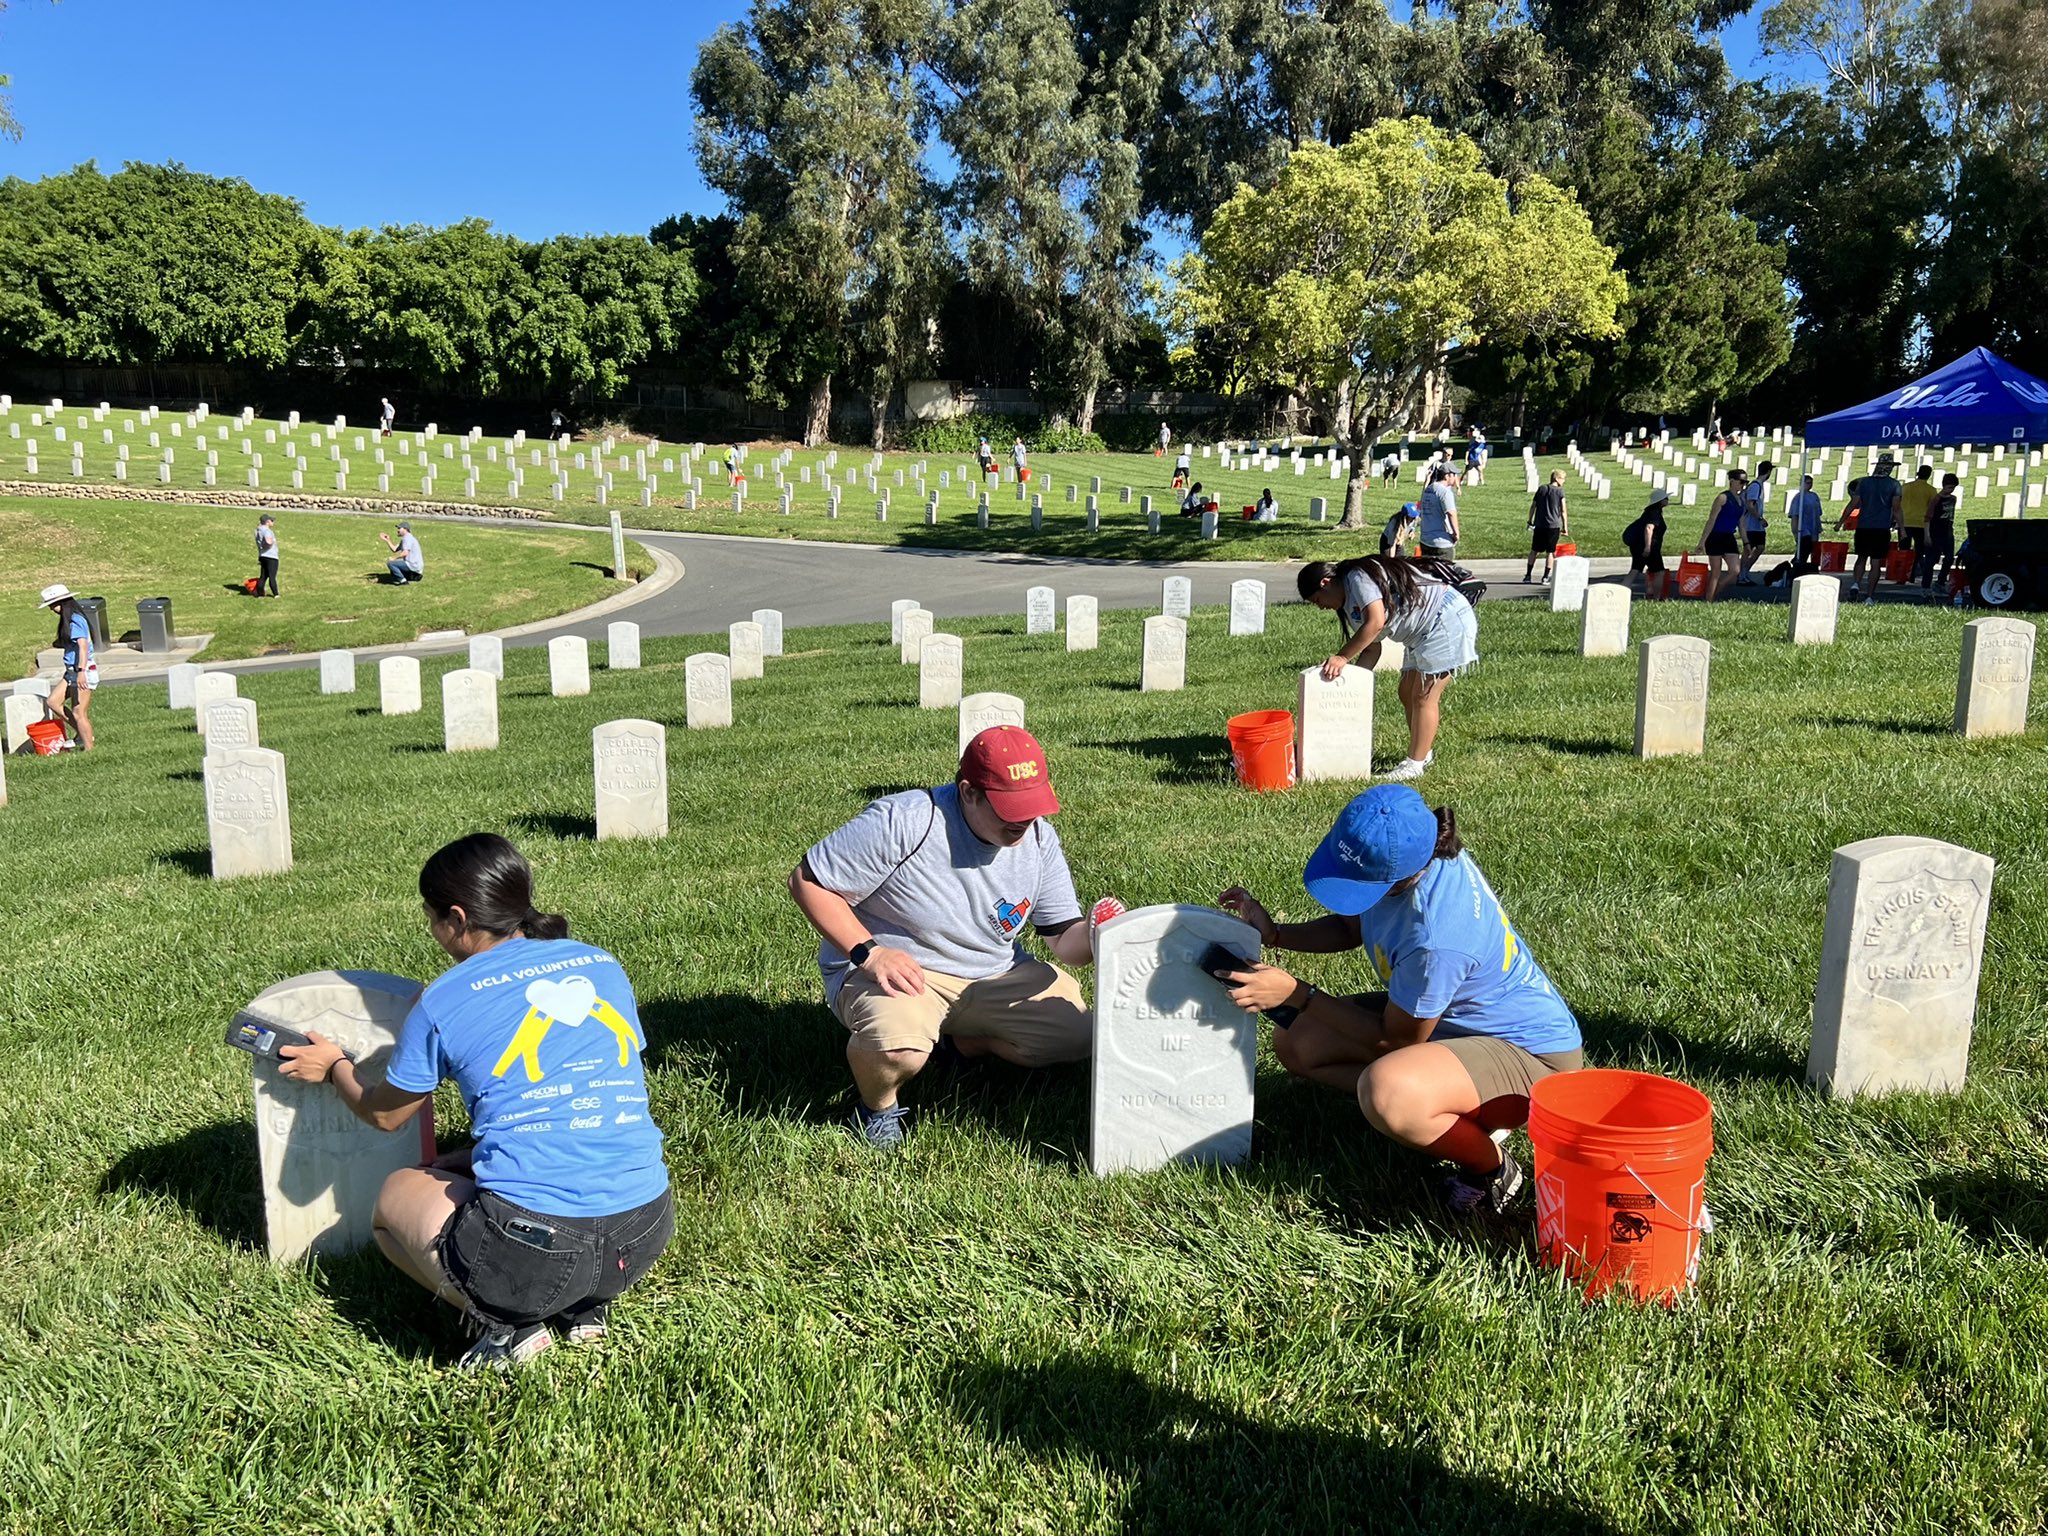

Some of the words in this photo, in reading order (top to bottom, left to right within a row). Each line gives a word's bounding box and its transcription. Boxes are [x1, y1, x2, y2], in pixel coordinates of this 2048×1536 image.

[1881, 418, 1941, 440] DASANI
[1006, 760, 1039, 781] USC
[1473, 890, 1481, 920] UCLA
[1863, 887, 1927, 948] FRANCIS
[1933, 891, 1970, 948] STORM
[470, 973, 512, 991] UCLA
[512, 954, 593, 981] VOLUNTEER
[594, 953, 615, 965] DAY
[1113, 950, 1174, 1010] SAMUEL
[1162, 1034, 1191, 1052] INF
[520, 1085, 558, 1100] WESCOM
[589, 1079, 606, 1089] UCLA
[615, 1095, 631, 1103] UCLA
[1120, 1094, 1158, 1109] NOV
